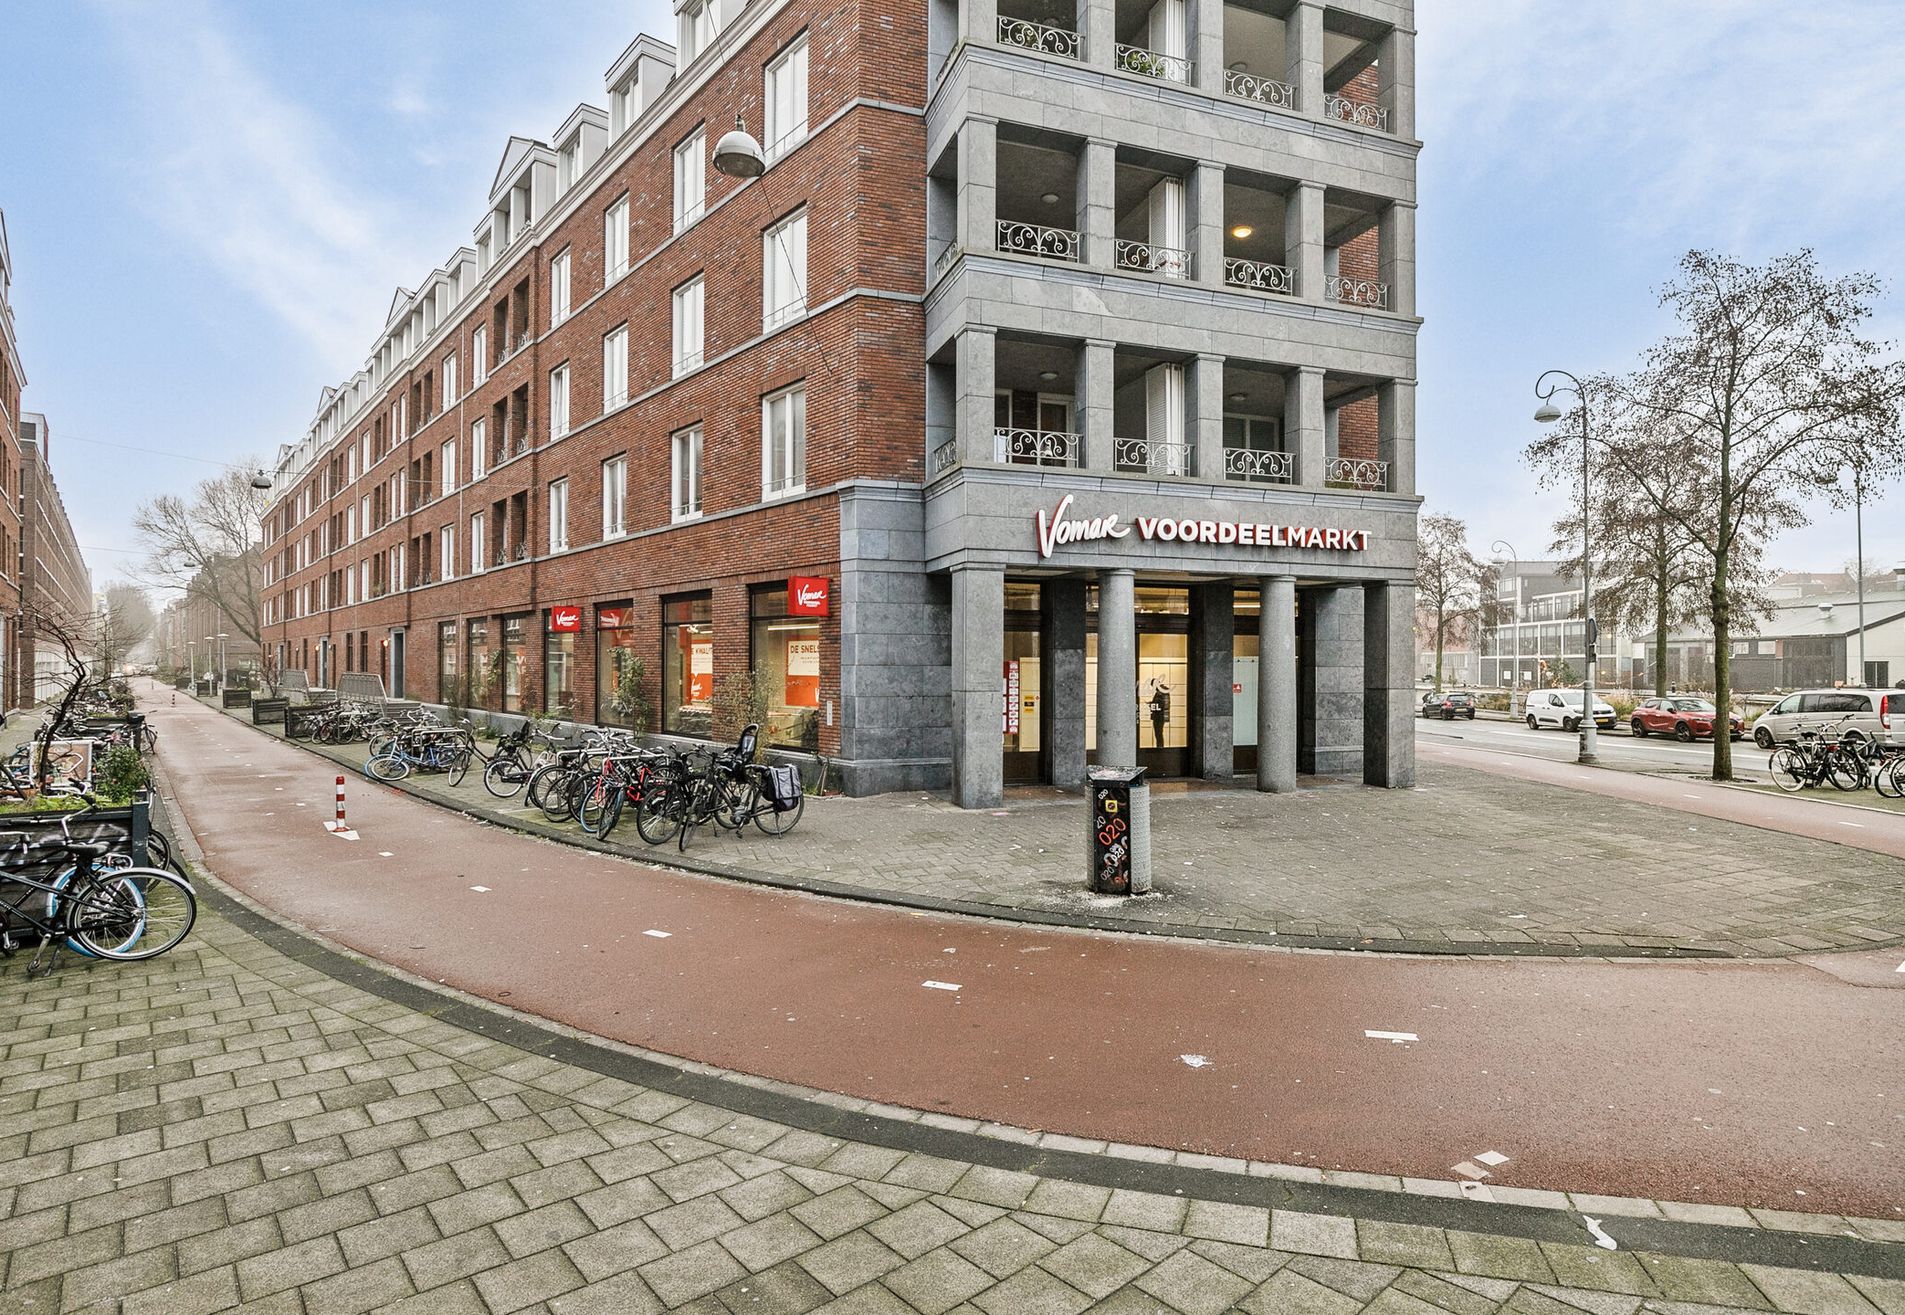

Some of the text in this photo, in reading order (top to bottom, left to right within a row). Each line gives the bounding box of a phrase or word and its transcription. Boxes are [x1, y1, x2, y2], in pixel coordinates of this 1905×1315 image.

[1136, 516, 1372, 551] VOORDEELMARKT
[790, 645, 799, 654] DE
[1099, 818, 1126, 845] 020
